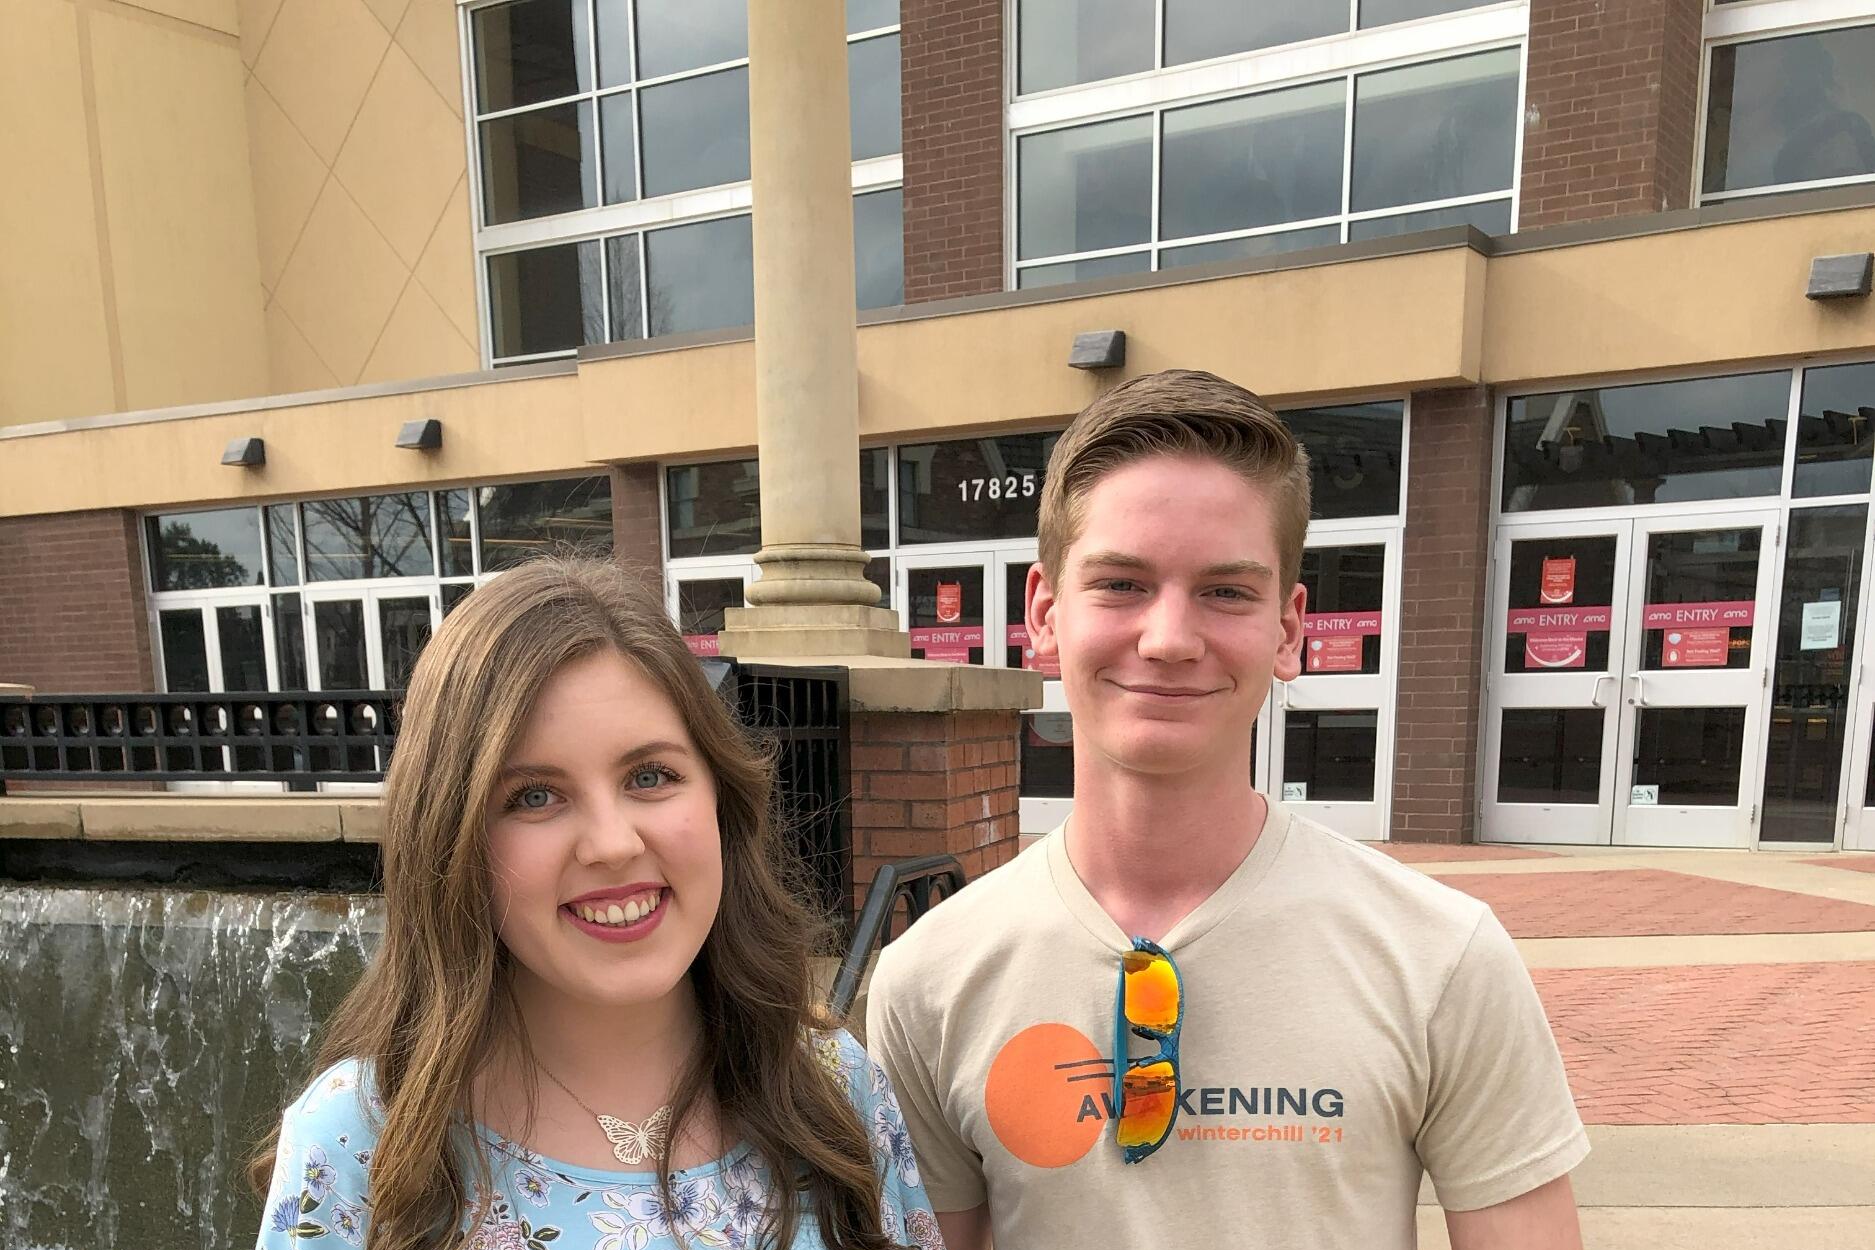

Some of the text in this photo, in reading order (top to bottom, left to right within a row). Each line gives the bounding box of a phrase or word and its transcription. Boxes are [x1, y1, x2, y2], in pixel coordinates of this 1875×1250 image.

[959, 475, 1035, 502] 17825
[1539, 613, 1579, 627] ENTRY
[1676, 608, 1718, 622] ENTRY
[1317, 618, 1353, 631] ENTRY
[700, 639, 719, 650] ENT
[932, 632, 961, 644] ENTRY
[1077, 1087, 1344, 1122] AKENING
[1177, 1125, 1343, 1143] winterchill '21
